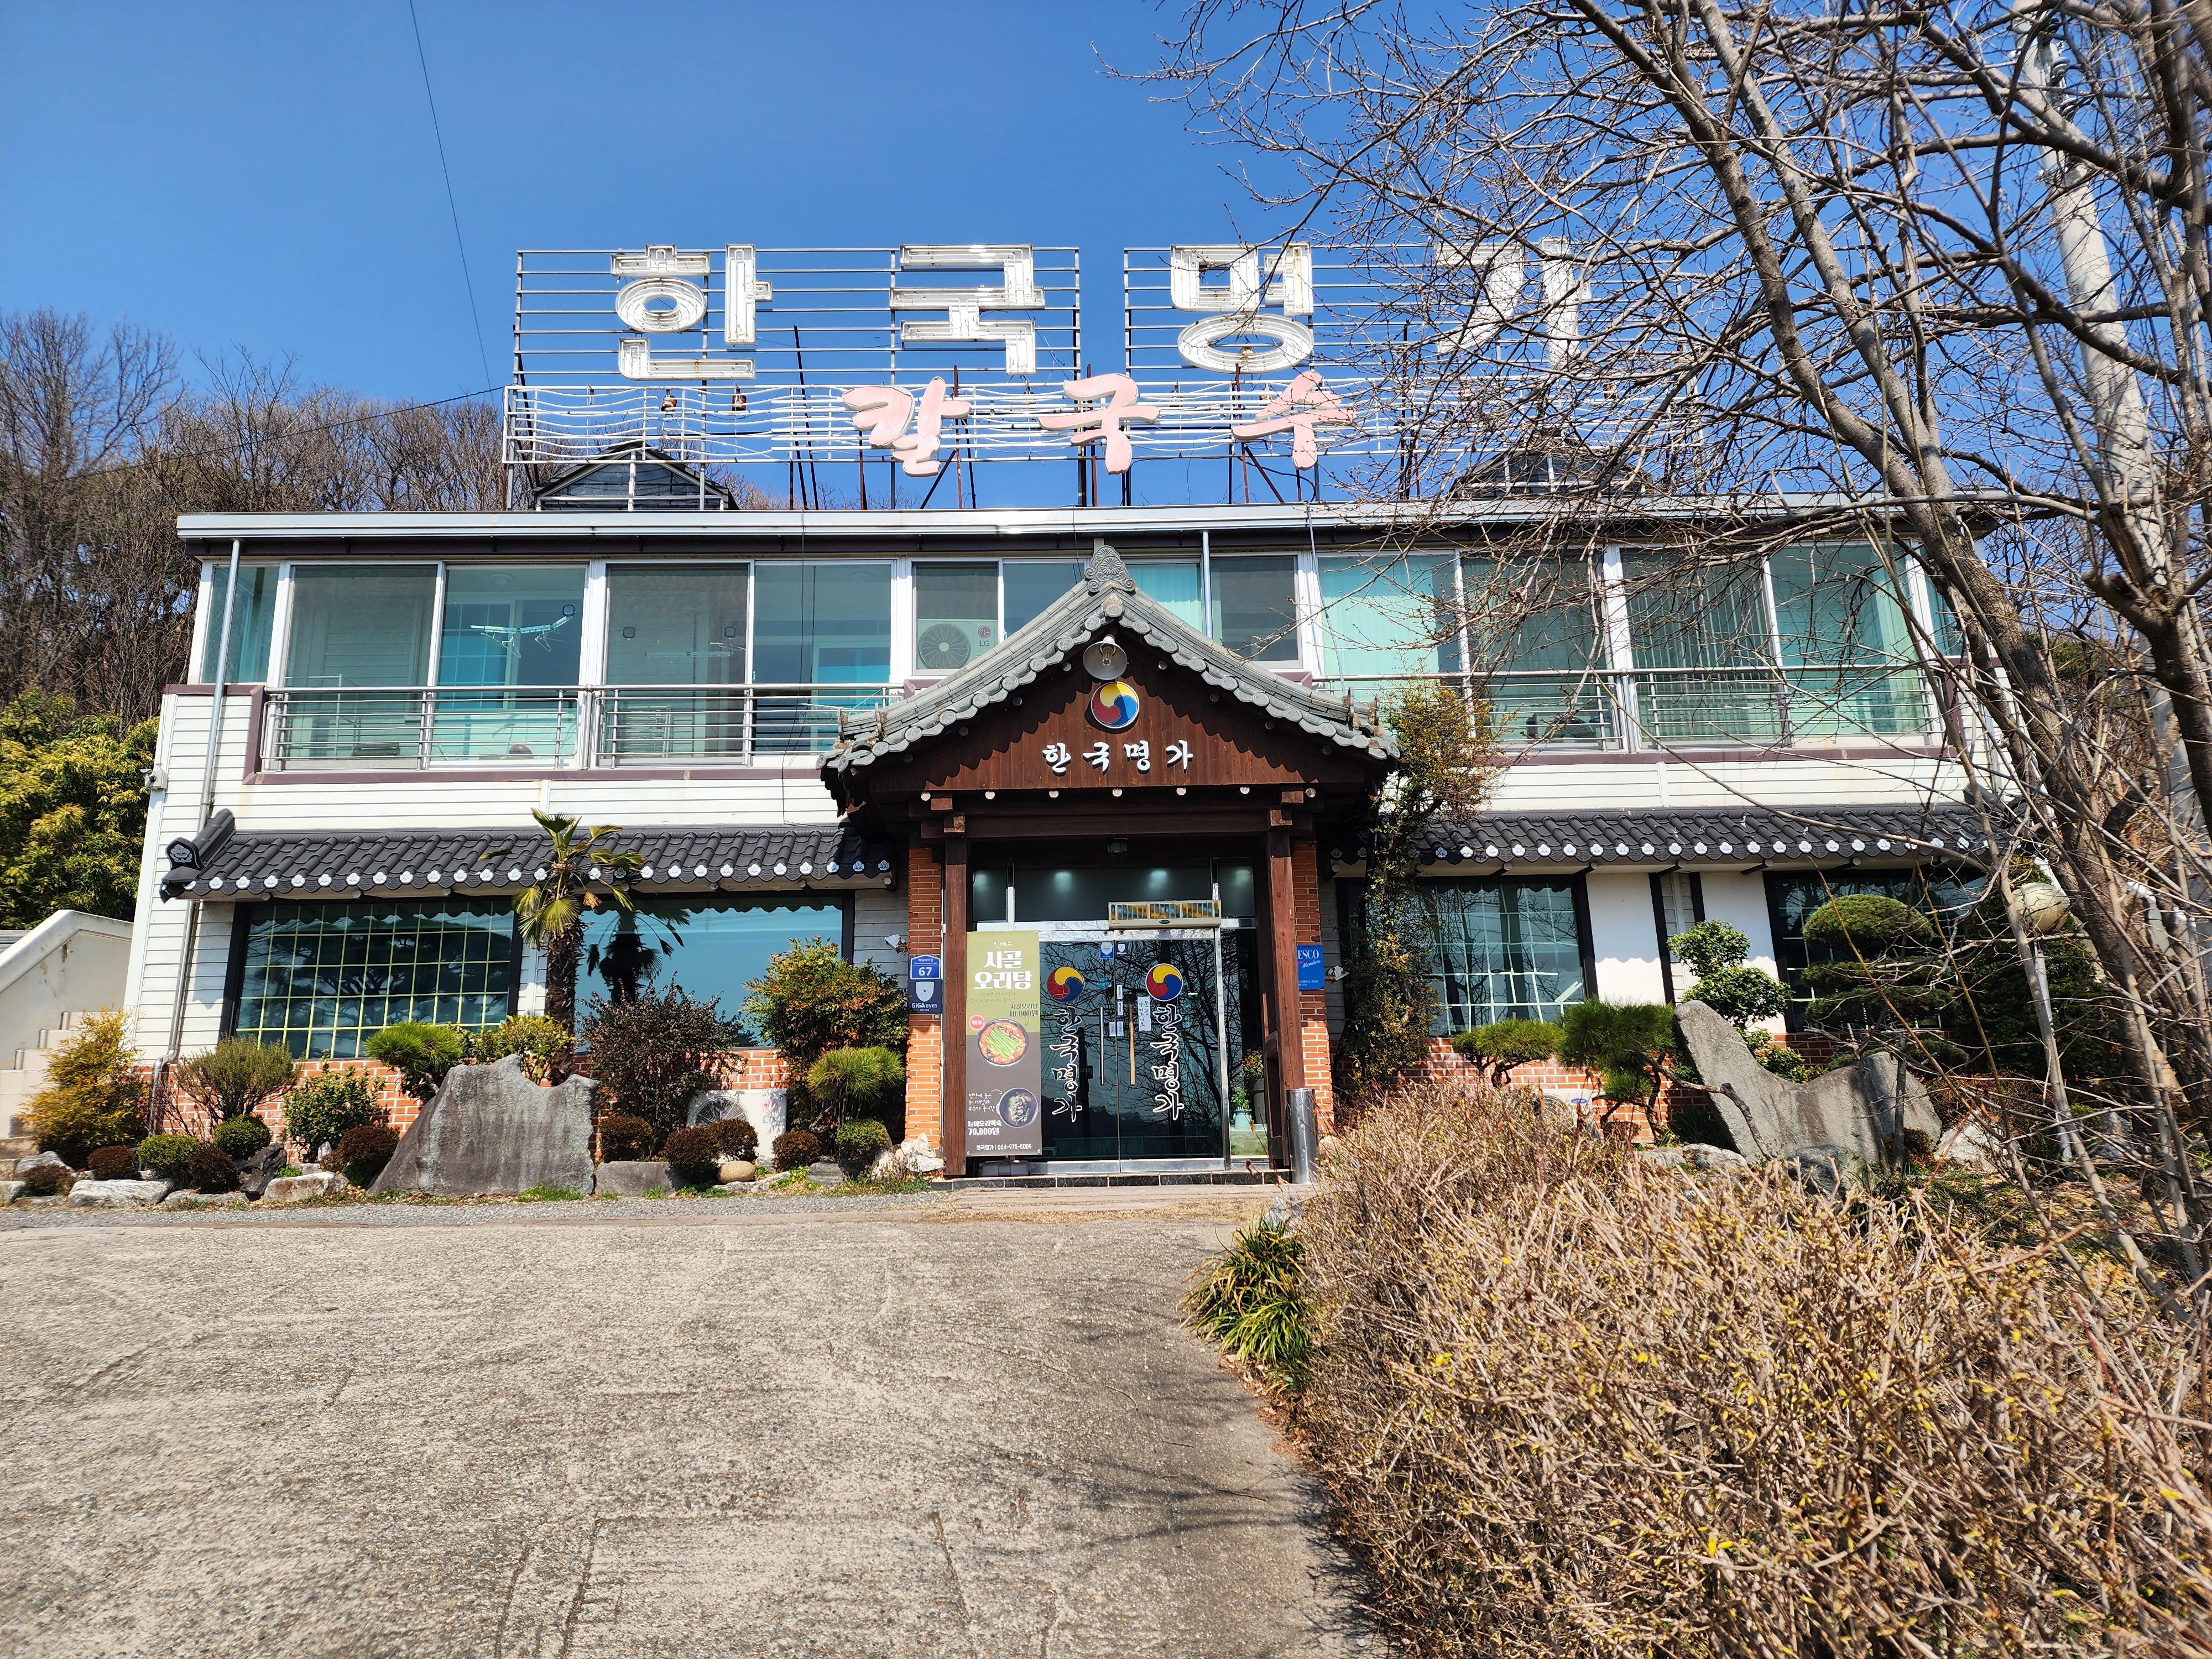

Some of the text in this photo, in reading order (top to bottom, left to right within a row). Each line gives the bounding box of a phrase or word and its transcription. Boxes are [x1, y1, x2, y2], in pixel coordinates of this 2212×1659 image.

[842, 370, 1357, 478] 칼국수
[1042, 739, 1193, 776] 한국명가
[983, 951, 1022, 969] 사골
[1297, 949, 1319, 959] ESCO
[919, 967, 932, 976] 67
[973, 971, 1032, 989] 오리탕
[1049, 1005, 1083, 1123] 한국명가
[1150, 1004, 1185, 1121] 한국명가
[968, 1127, 1000, 1136] 70,000원
